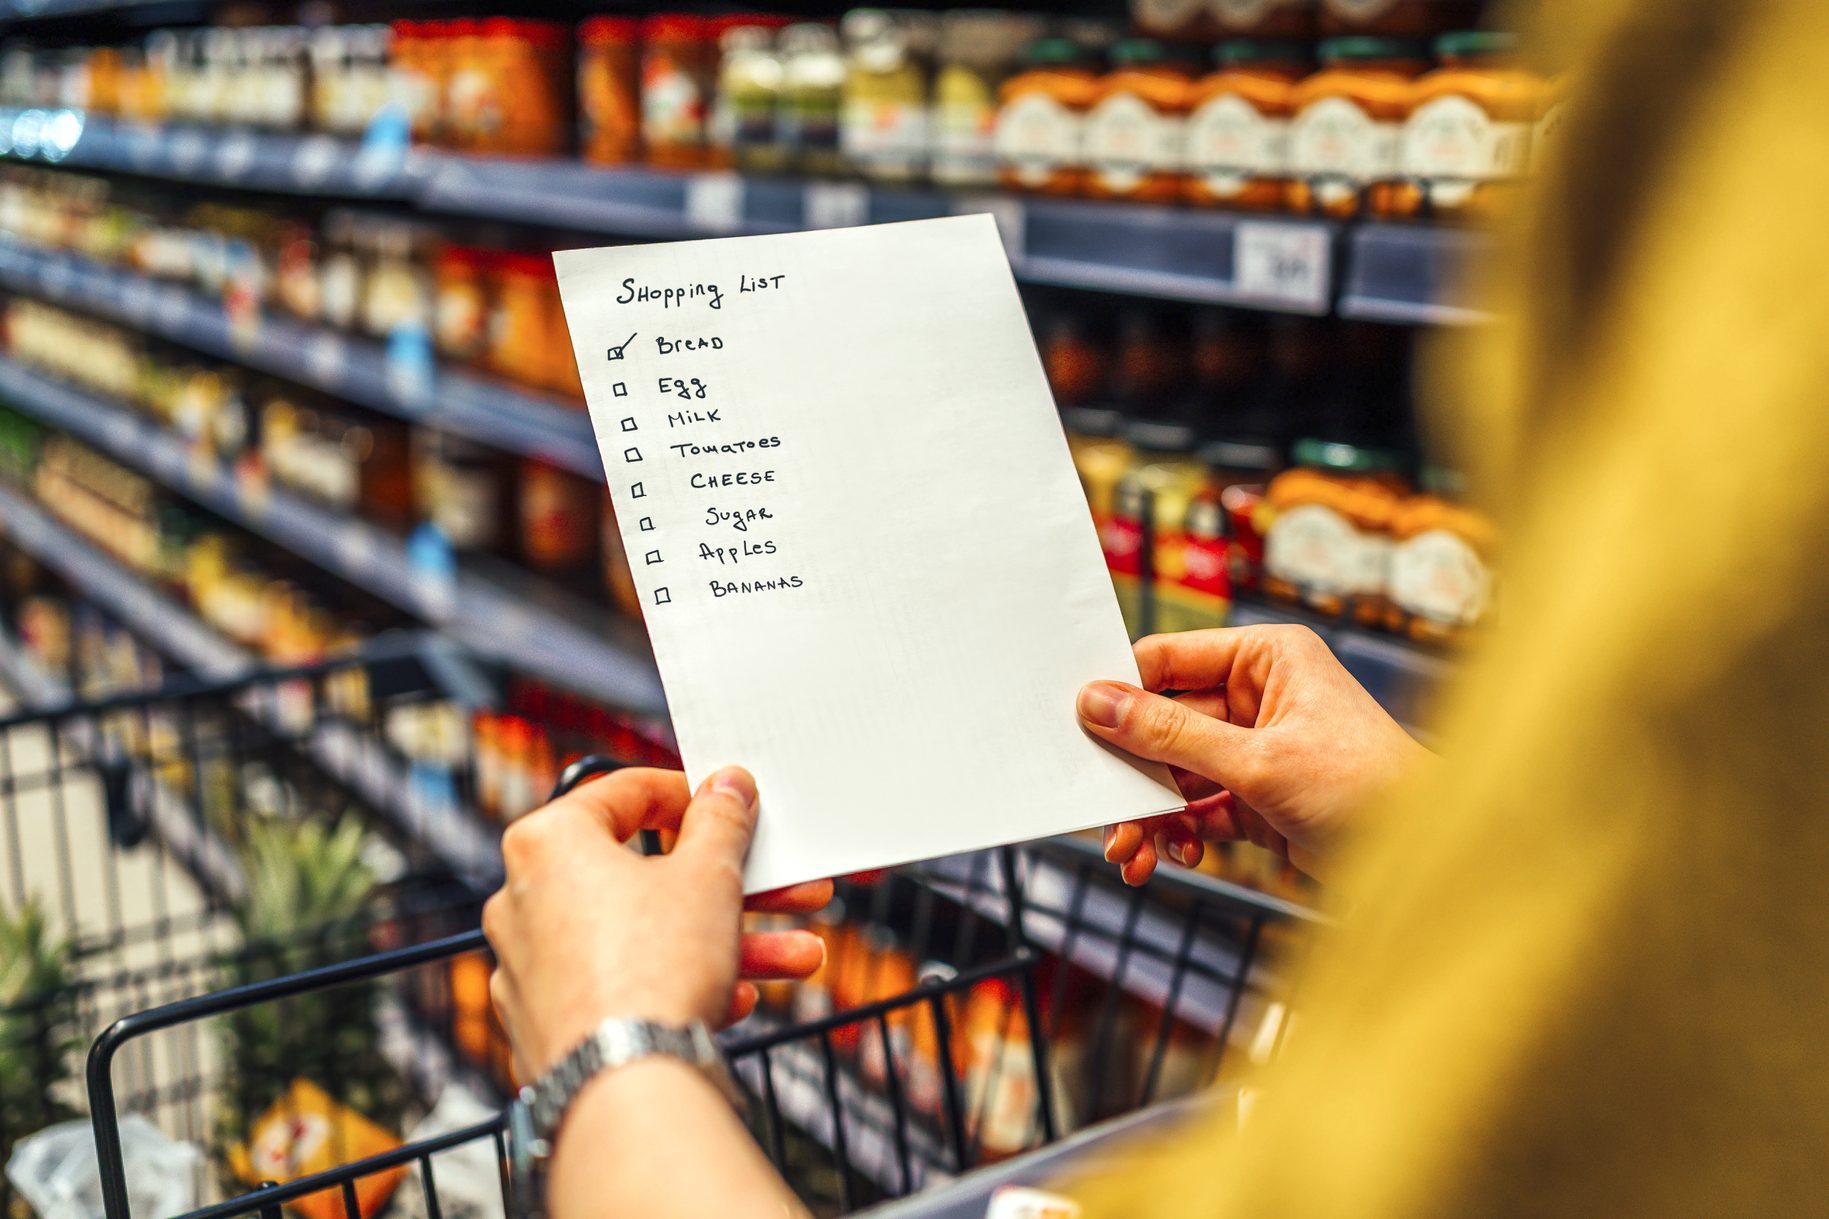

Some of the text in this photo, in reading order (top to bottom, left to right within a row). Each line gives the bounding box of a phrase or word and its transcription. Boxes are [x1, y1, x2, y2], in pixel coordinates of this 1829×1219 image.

[658, 377, 707, 400] Egg
[690, 470, 775, 489] CHEESE
[708, 575, 804, 598] BANANAS
